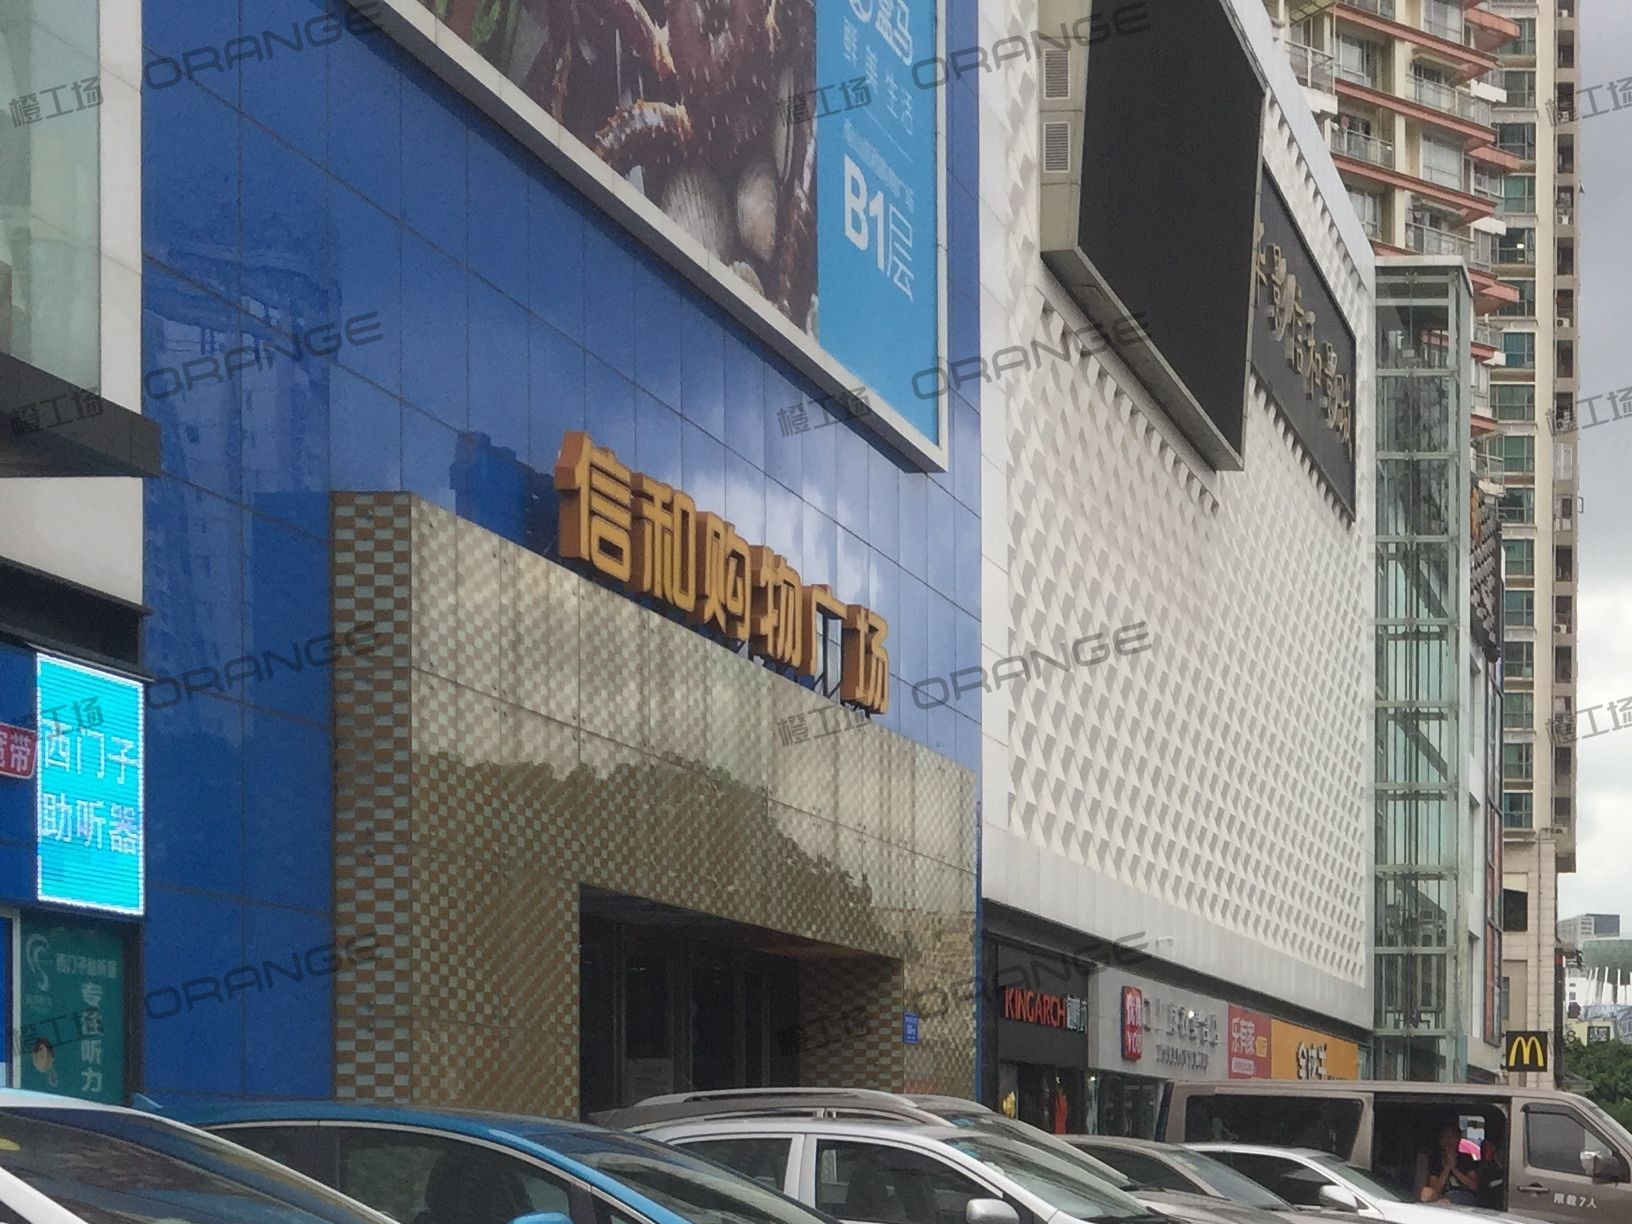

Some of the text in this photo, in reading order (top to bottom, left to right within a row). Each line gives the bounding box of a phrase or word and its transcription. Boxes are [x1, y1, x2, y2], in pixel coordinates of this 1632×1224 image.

[844, 153, 915, 303] B1层
[554, 431, 889, 715] 信和购物广场
[41, 719, 138, 785] 西门子
[41, 792, 138, 855] 助听器
[1004, 986, 1066, 1029] KINGARCH
